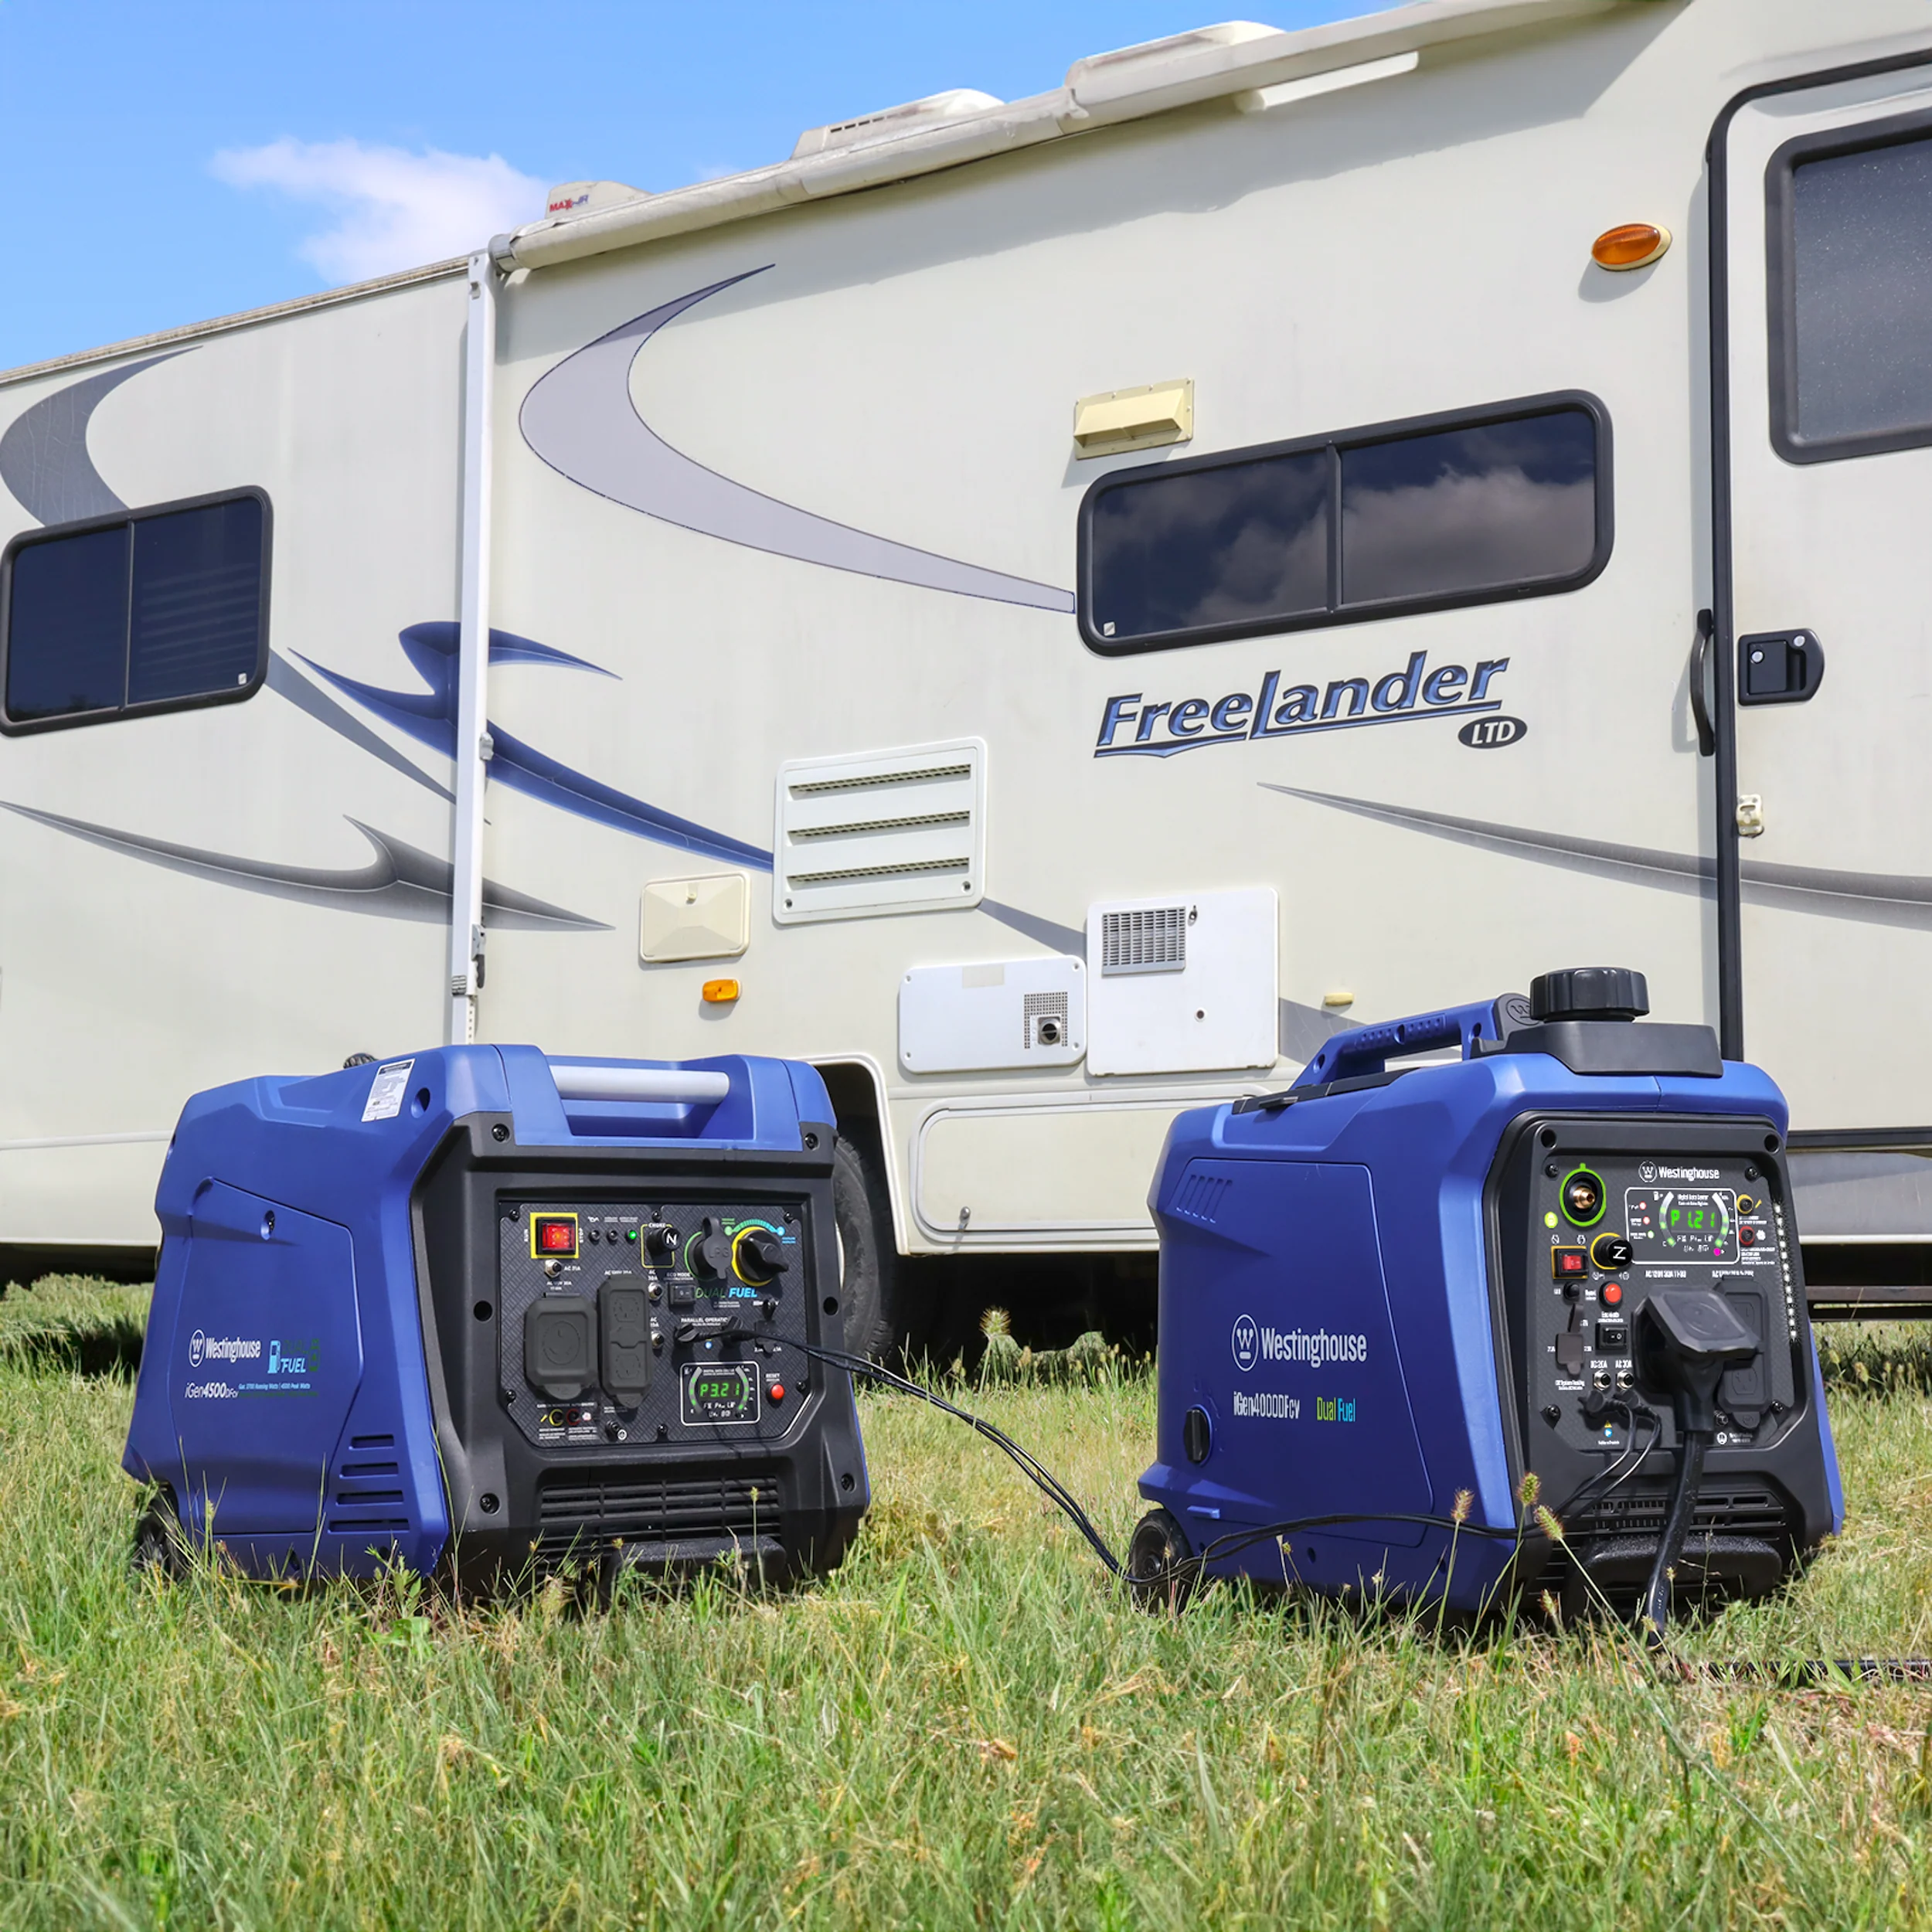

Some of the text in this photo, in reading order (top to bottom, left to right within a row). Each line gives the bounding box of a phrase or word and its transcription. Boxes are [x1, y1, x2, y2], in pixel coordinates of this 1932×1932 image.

[1096, 650, 1510, 747] Freelander
[1471, 719, 1517, 746] LTD
[1658, 1166, 1720, 1182] Westinghouse
[696, 1287, 758, 1299] DUAL FUEL
[206, 1336, 261, 1363] Westinghouse
[1260, 1328, 1367, 1368] Westinghouse
[281, 1358, 306, 1373] FUEL
[1317, 1396, 1355, 1422] Dual Fuel
